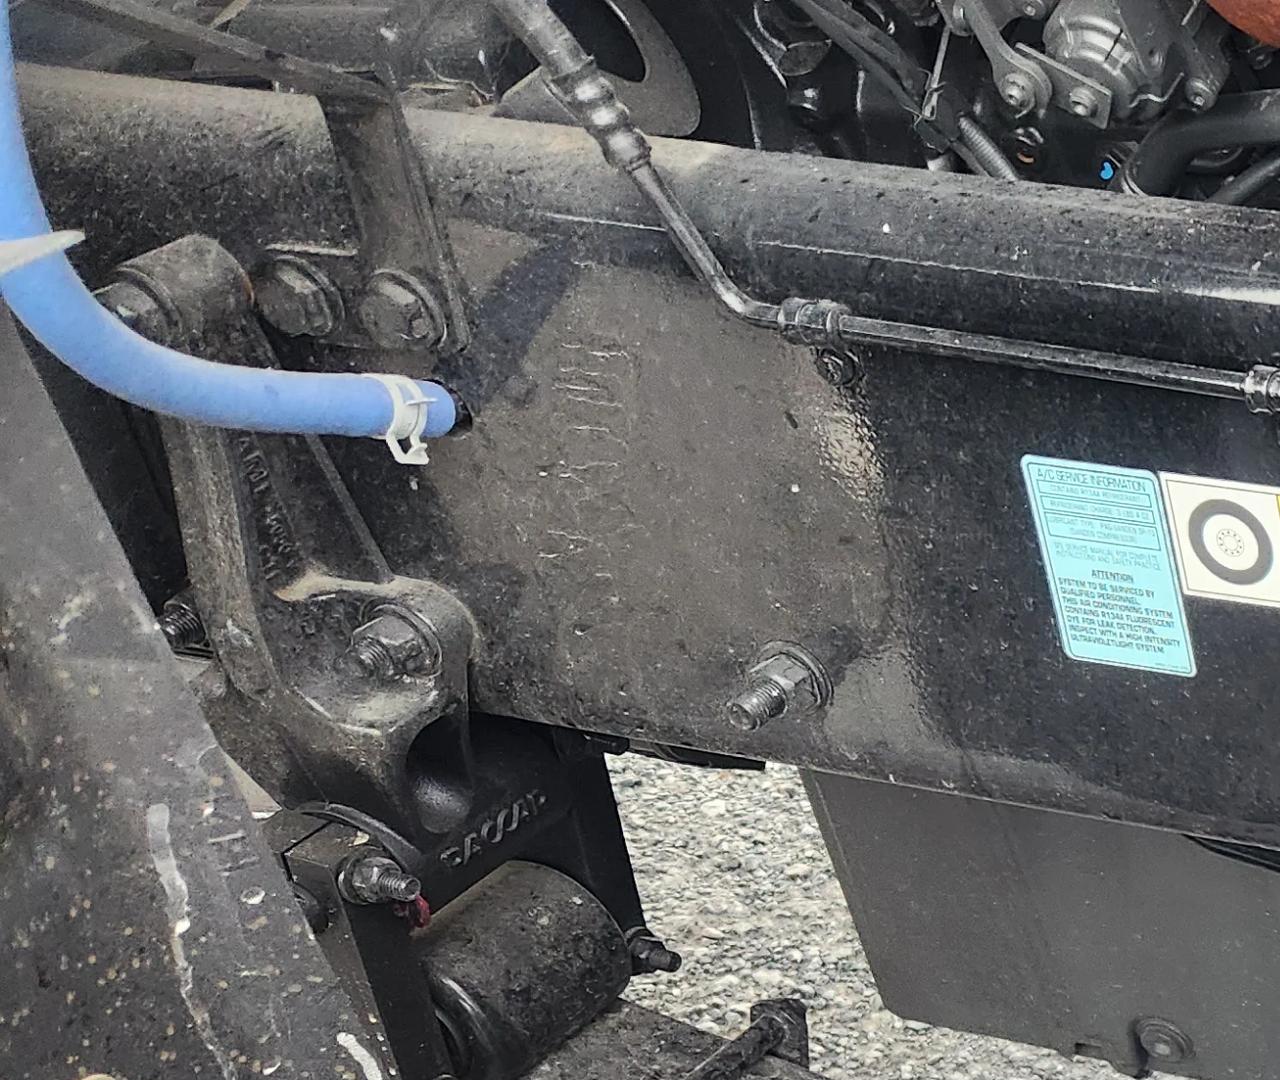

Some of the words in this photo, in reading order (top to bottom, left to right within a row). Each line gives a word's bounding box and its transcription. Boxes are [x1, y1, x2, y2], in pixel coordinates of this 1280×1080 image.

[1036, 469, 1055, 479] A/C
[1056, 471, 1087, 483] SERVICE
[1090, 476, 1145, 491] INFORMATION
[1091, 570, 1134, 583] ATTENTION
[1058, 577, 1085, 587] SYSTEM
[1087, 582, 1098, 590] TO
[1098, 583, 1109, 591] BE
[1110, 585, 1143, 596] SERVICED
[1060, 587, 1094, 597] QUALIFIED
[1062, 596, 1077, 604] THIS
[1079, 599, 1091, 607] AIR
[1092, 601, 1142, 614] CONDITIONING
[1145, 609, 1173, 618] SYSTEM
[1064, 606, 1099, 616] CONTAINS
[1126, 615, 1175, 628] FLUORESCENT
[1066, 615, 1080, 623] DYE
[1081, 617, 1095, 626] FOR
[1097, 620, 1114, 628] LEAK
[1069, 624, 1096, 634] INSPECT
[1099, 629, 1117, 637] WITH
[1118, 631, 1124, 639] A
[1126, 633, 1142, 641] HIGH
[1144, 636, 1180, 647] INTENSITY
[1136, 644, 1164, 653] SYSTEM
